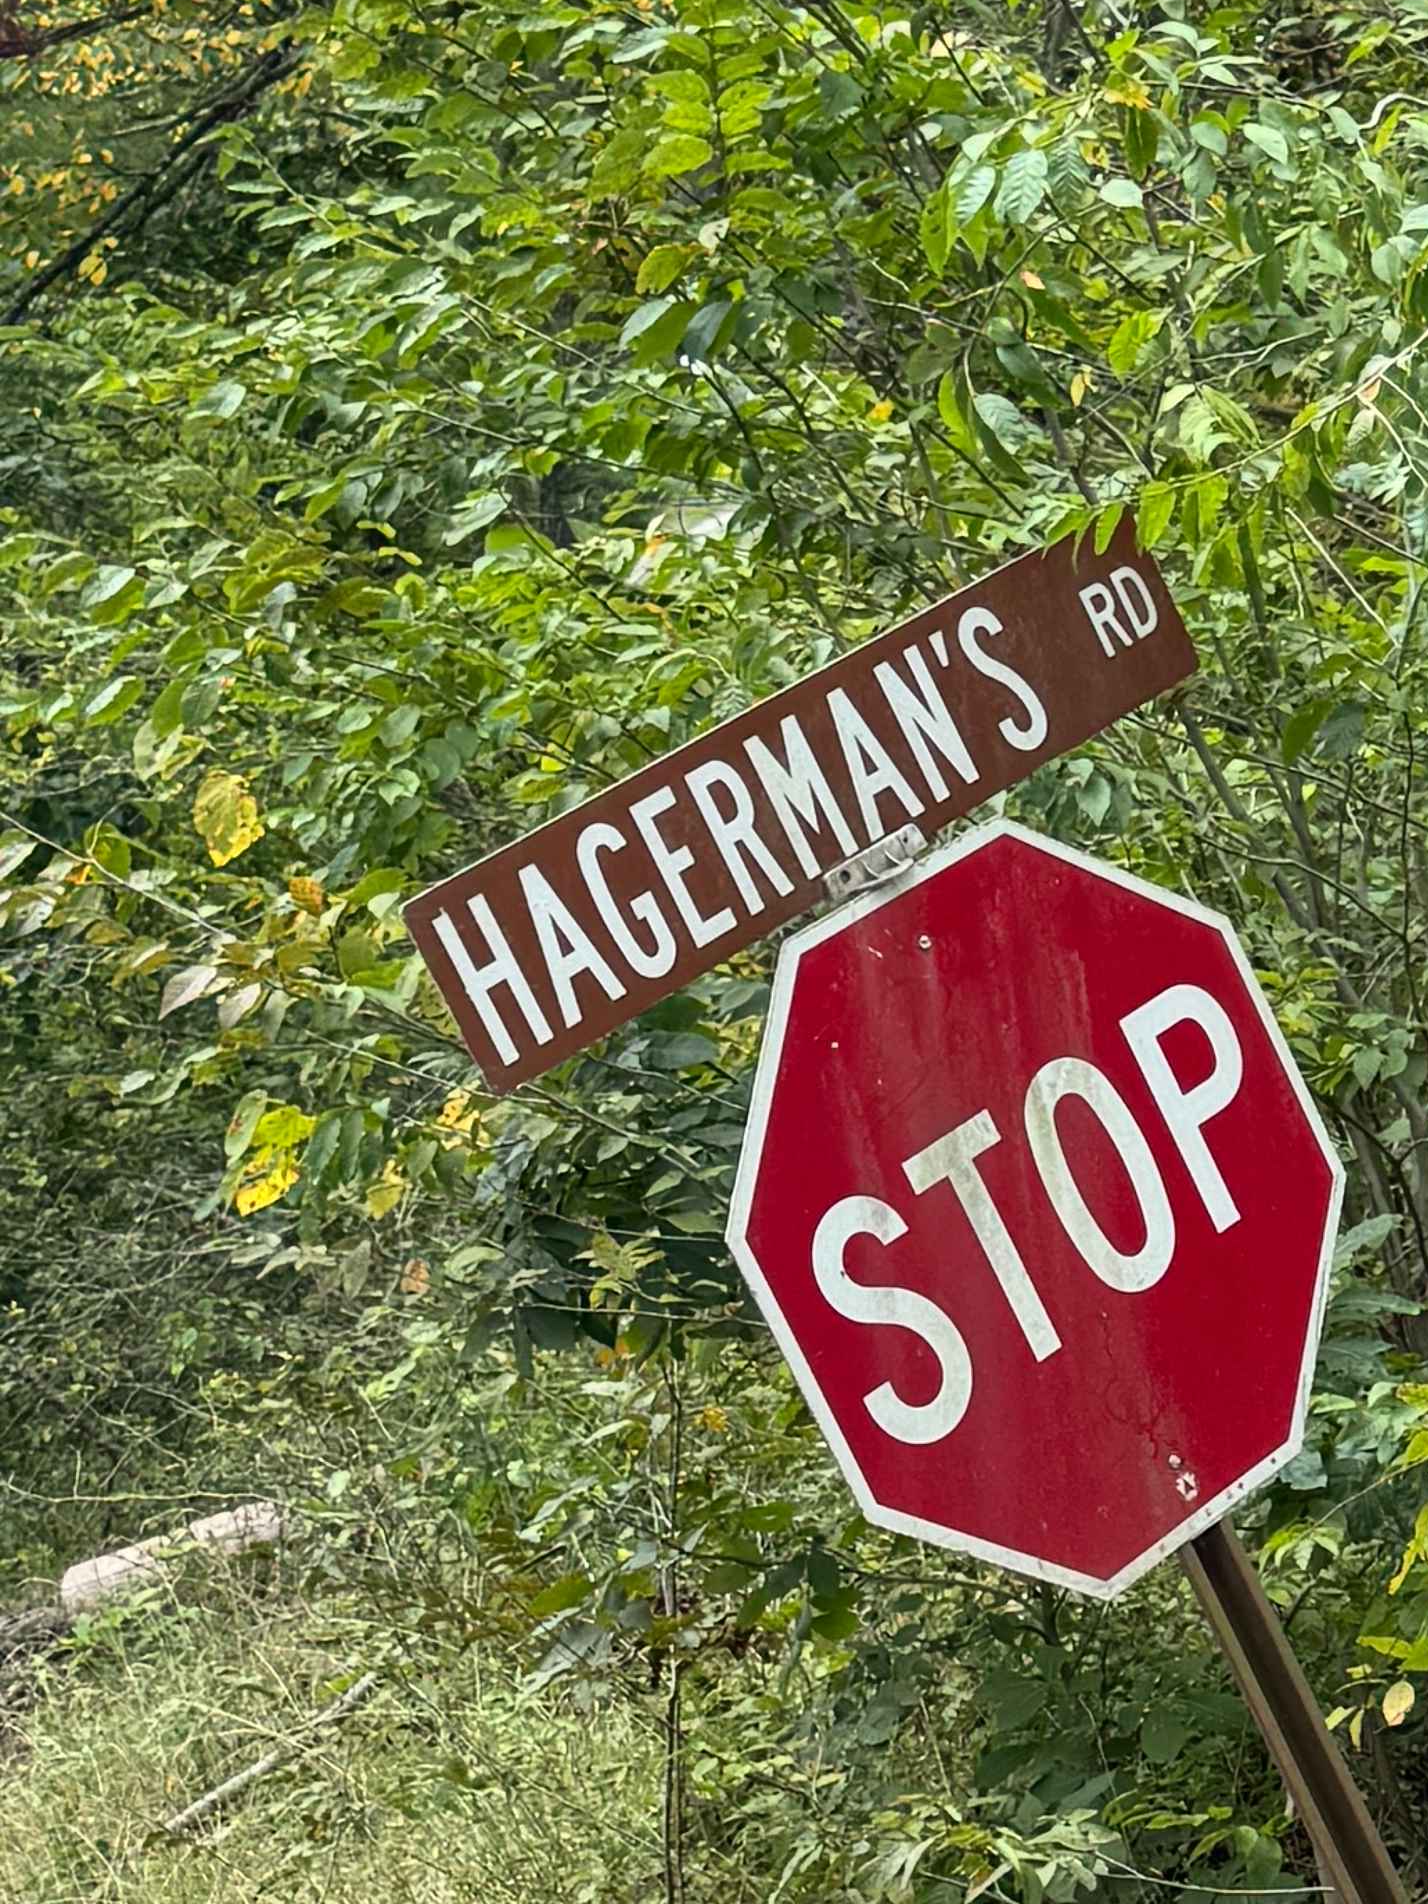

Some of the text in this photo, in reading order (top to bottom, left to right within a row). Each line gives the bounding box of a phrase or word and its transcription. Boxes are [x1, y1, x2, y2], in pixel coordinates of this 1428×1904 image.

[433, 565, 1158, 1065] HAGERMAN'S RD
[812, 984, 1244, 1445] STOP
